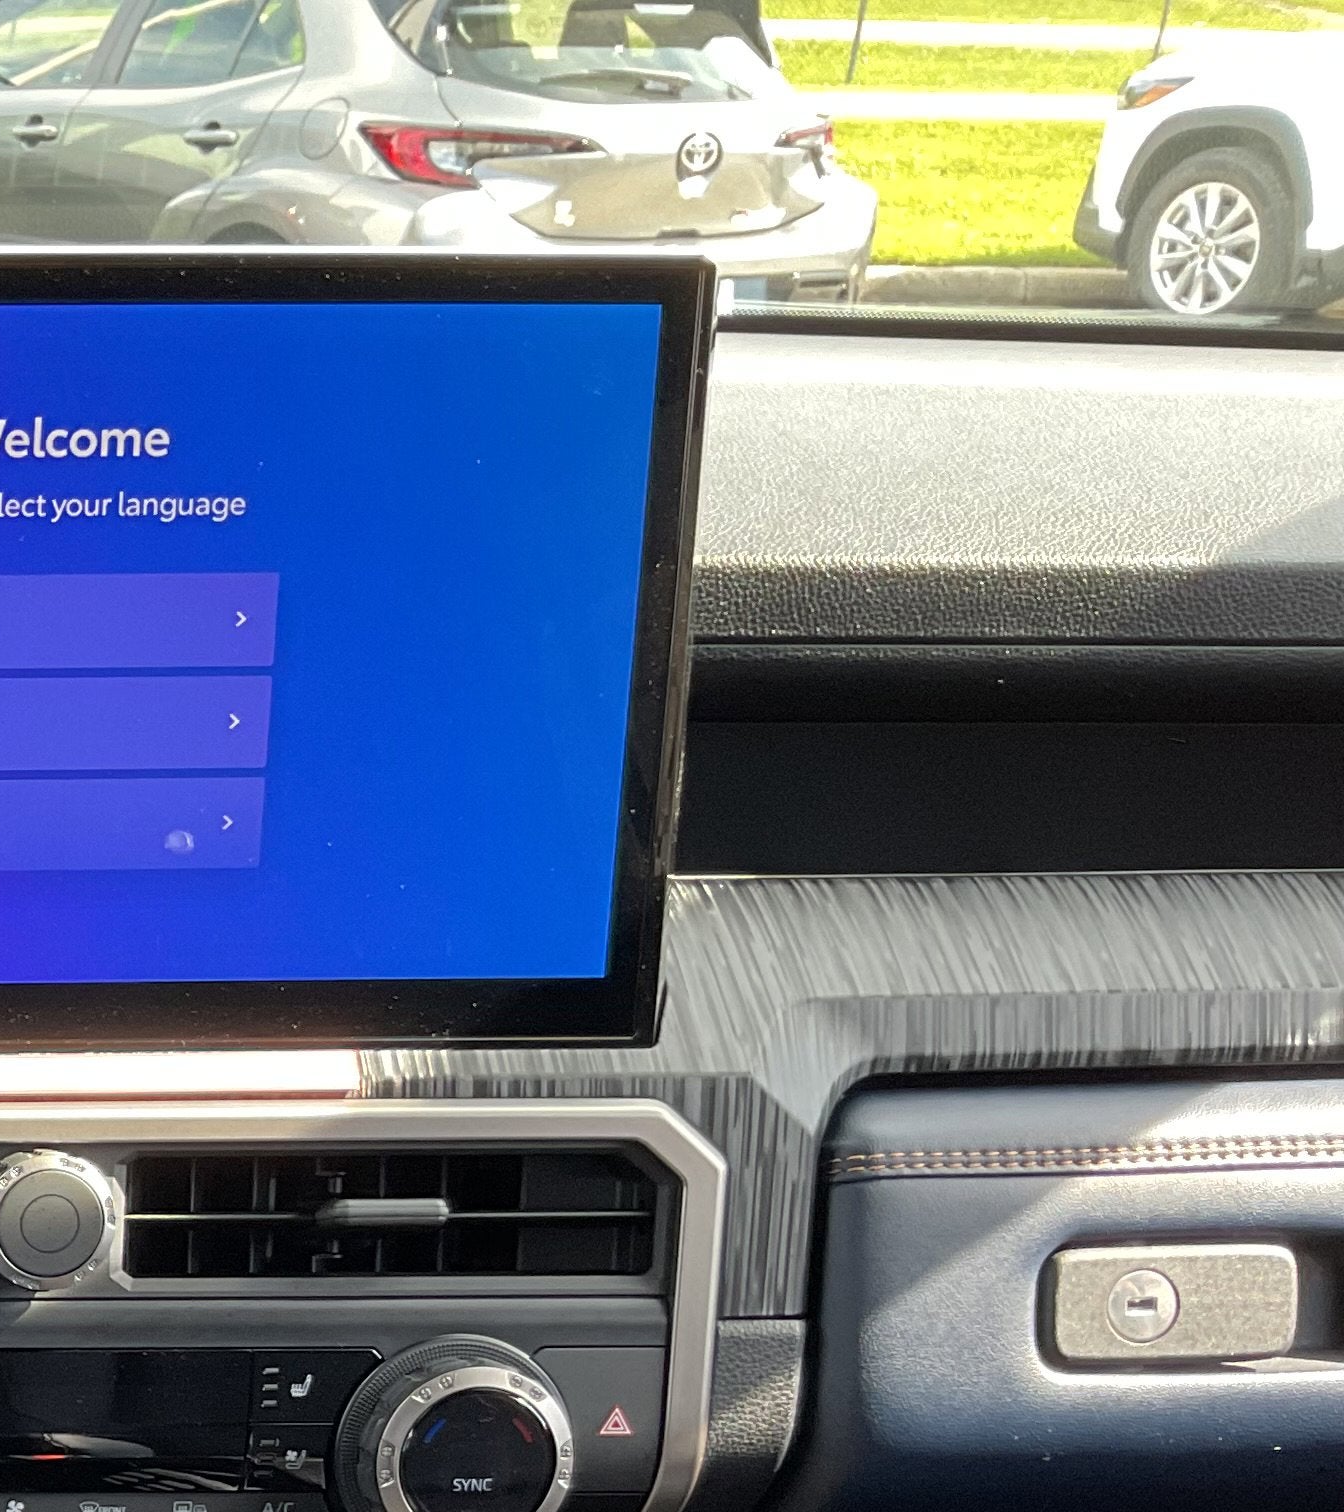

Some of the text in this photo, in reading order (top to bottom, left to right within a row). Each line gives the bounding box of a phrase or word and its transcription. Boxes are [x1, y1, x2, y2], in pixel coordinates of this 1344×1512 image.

[50, 497, 113, 523] your
[118, 490, 246, 523] language
[452, 1477, 493, 1492] SYNC
